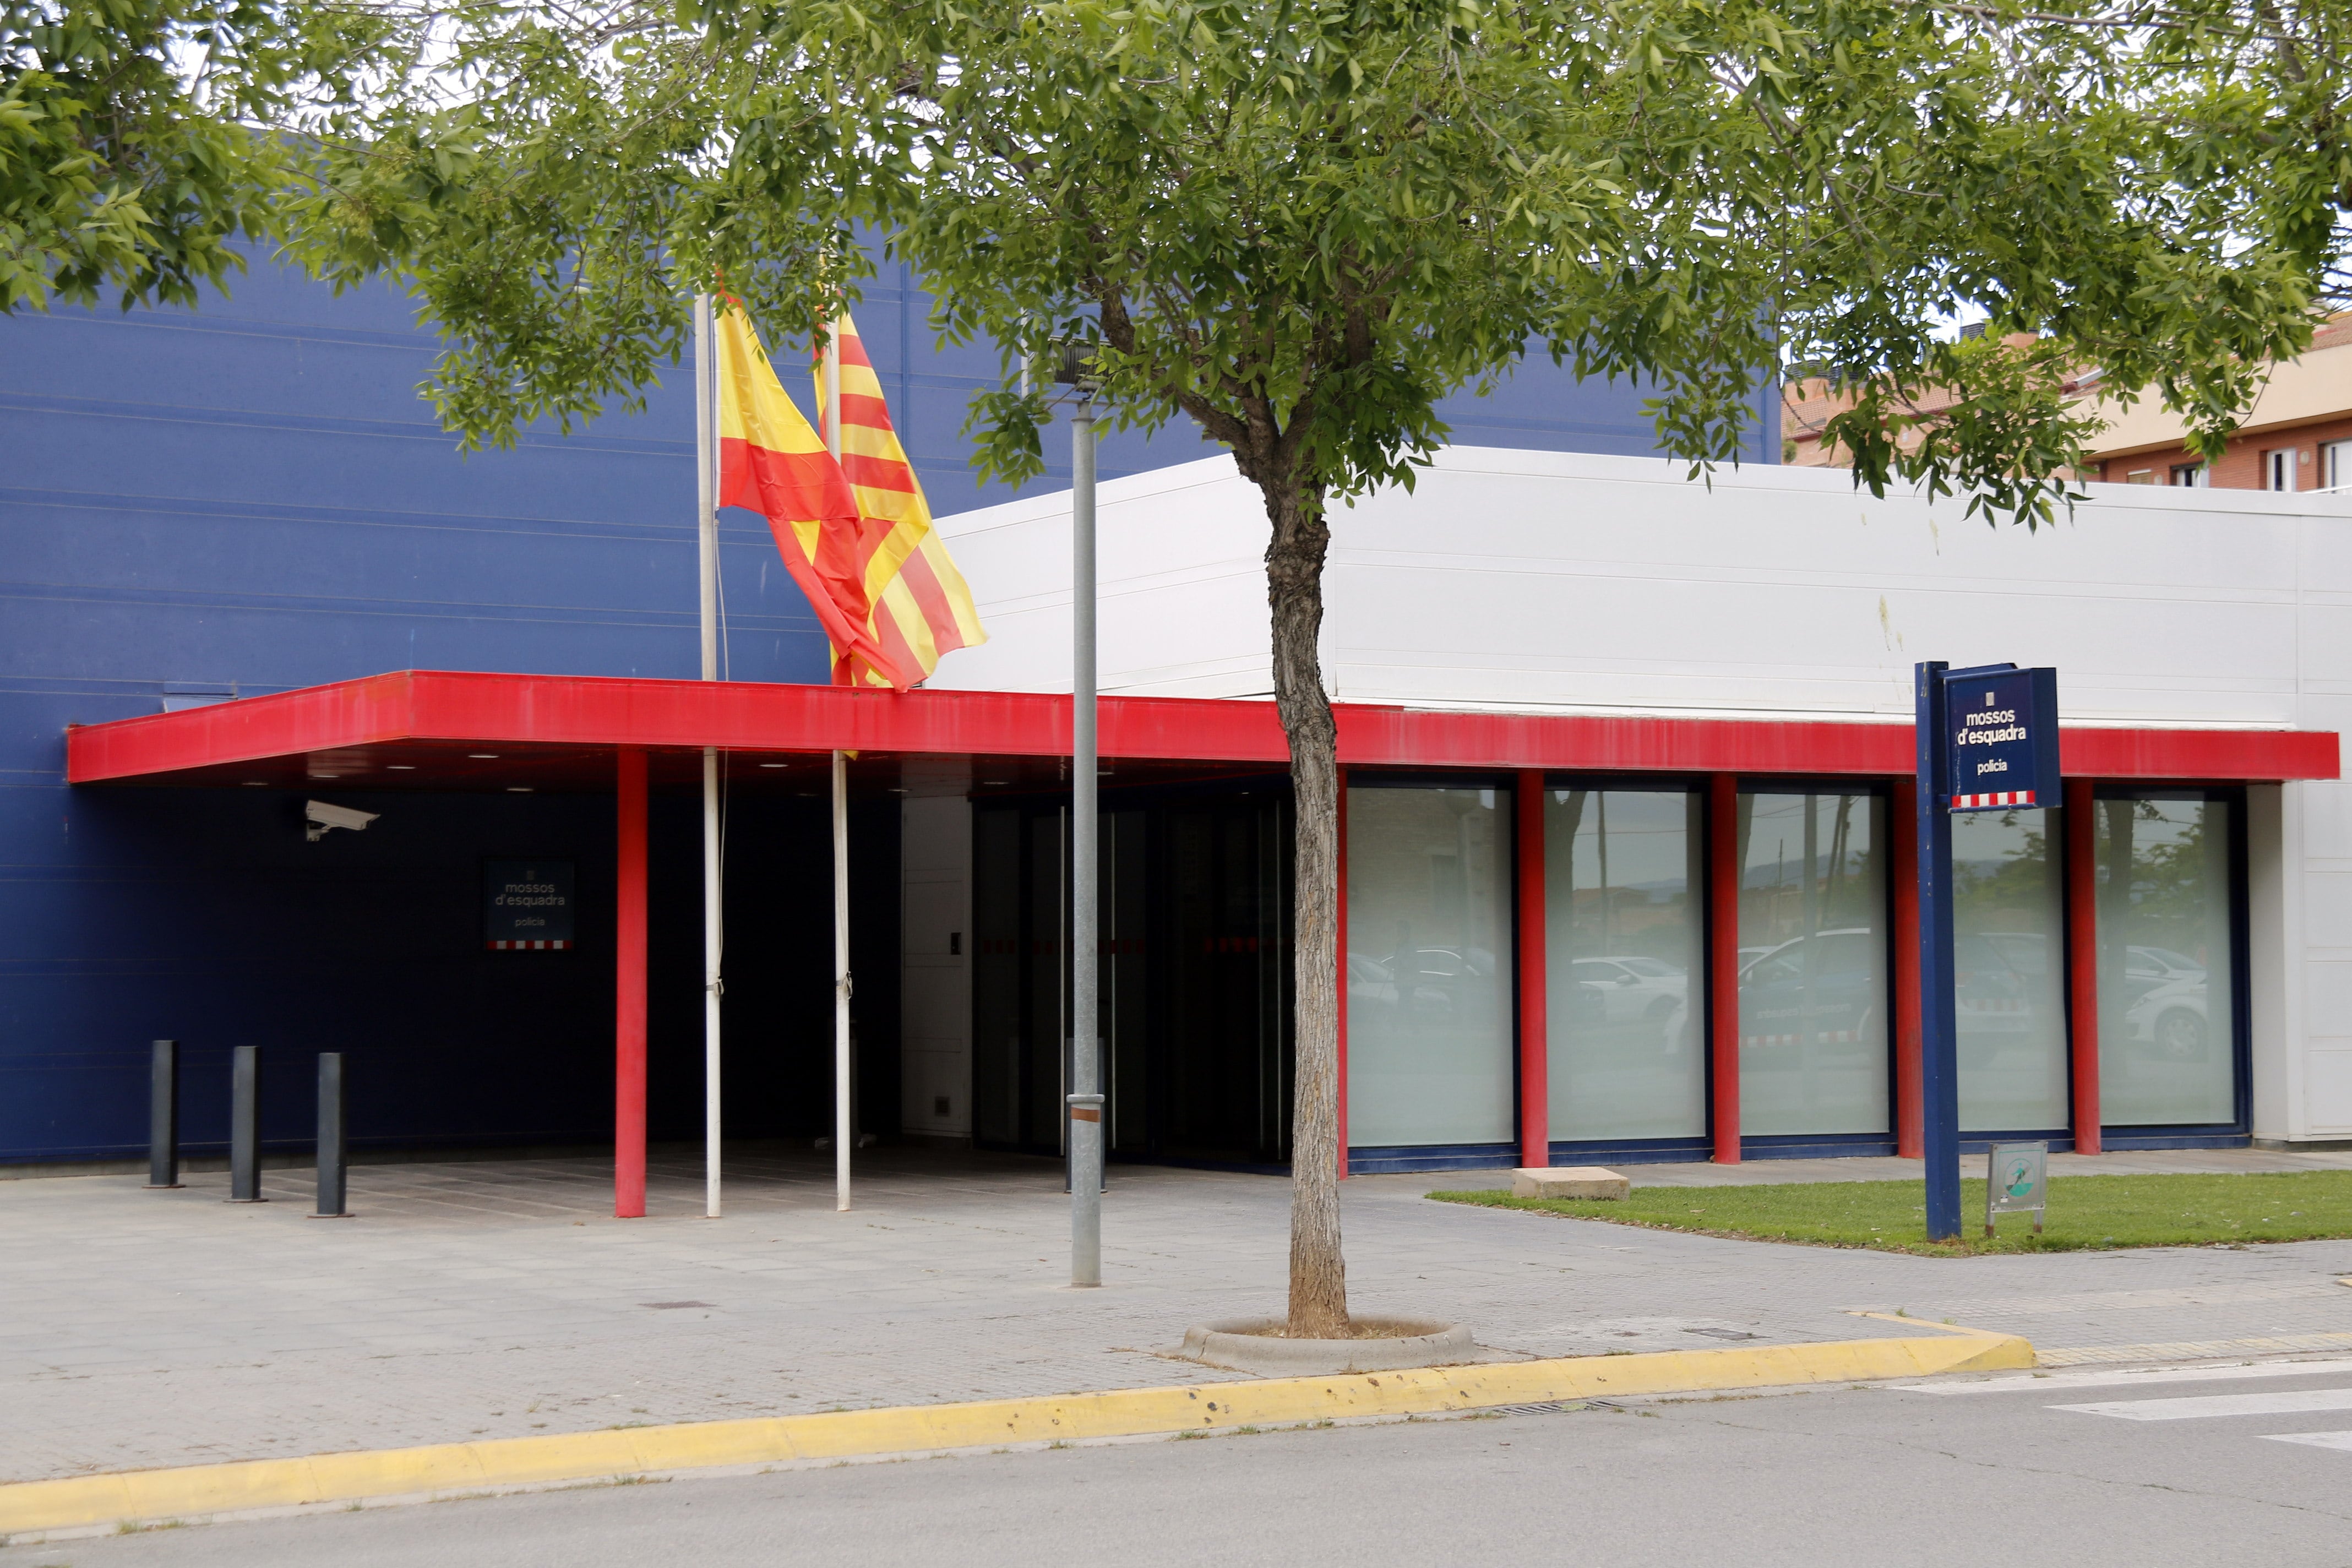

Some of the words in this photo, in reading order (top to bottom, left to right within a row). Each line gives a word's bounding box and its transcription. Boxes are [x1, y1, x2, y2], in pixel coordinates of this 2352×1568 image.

[1966, 709, 2015, 726] mossos
[1957, 724, 2026, 746] d'esquadra
[1977, 759, 2007, 775] policia
[505, 884, 555, 893] mossos
[496, 894, 565, 907] d'esquadra
[515, 917, 546, 927] policia
